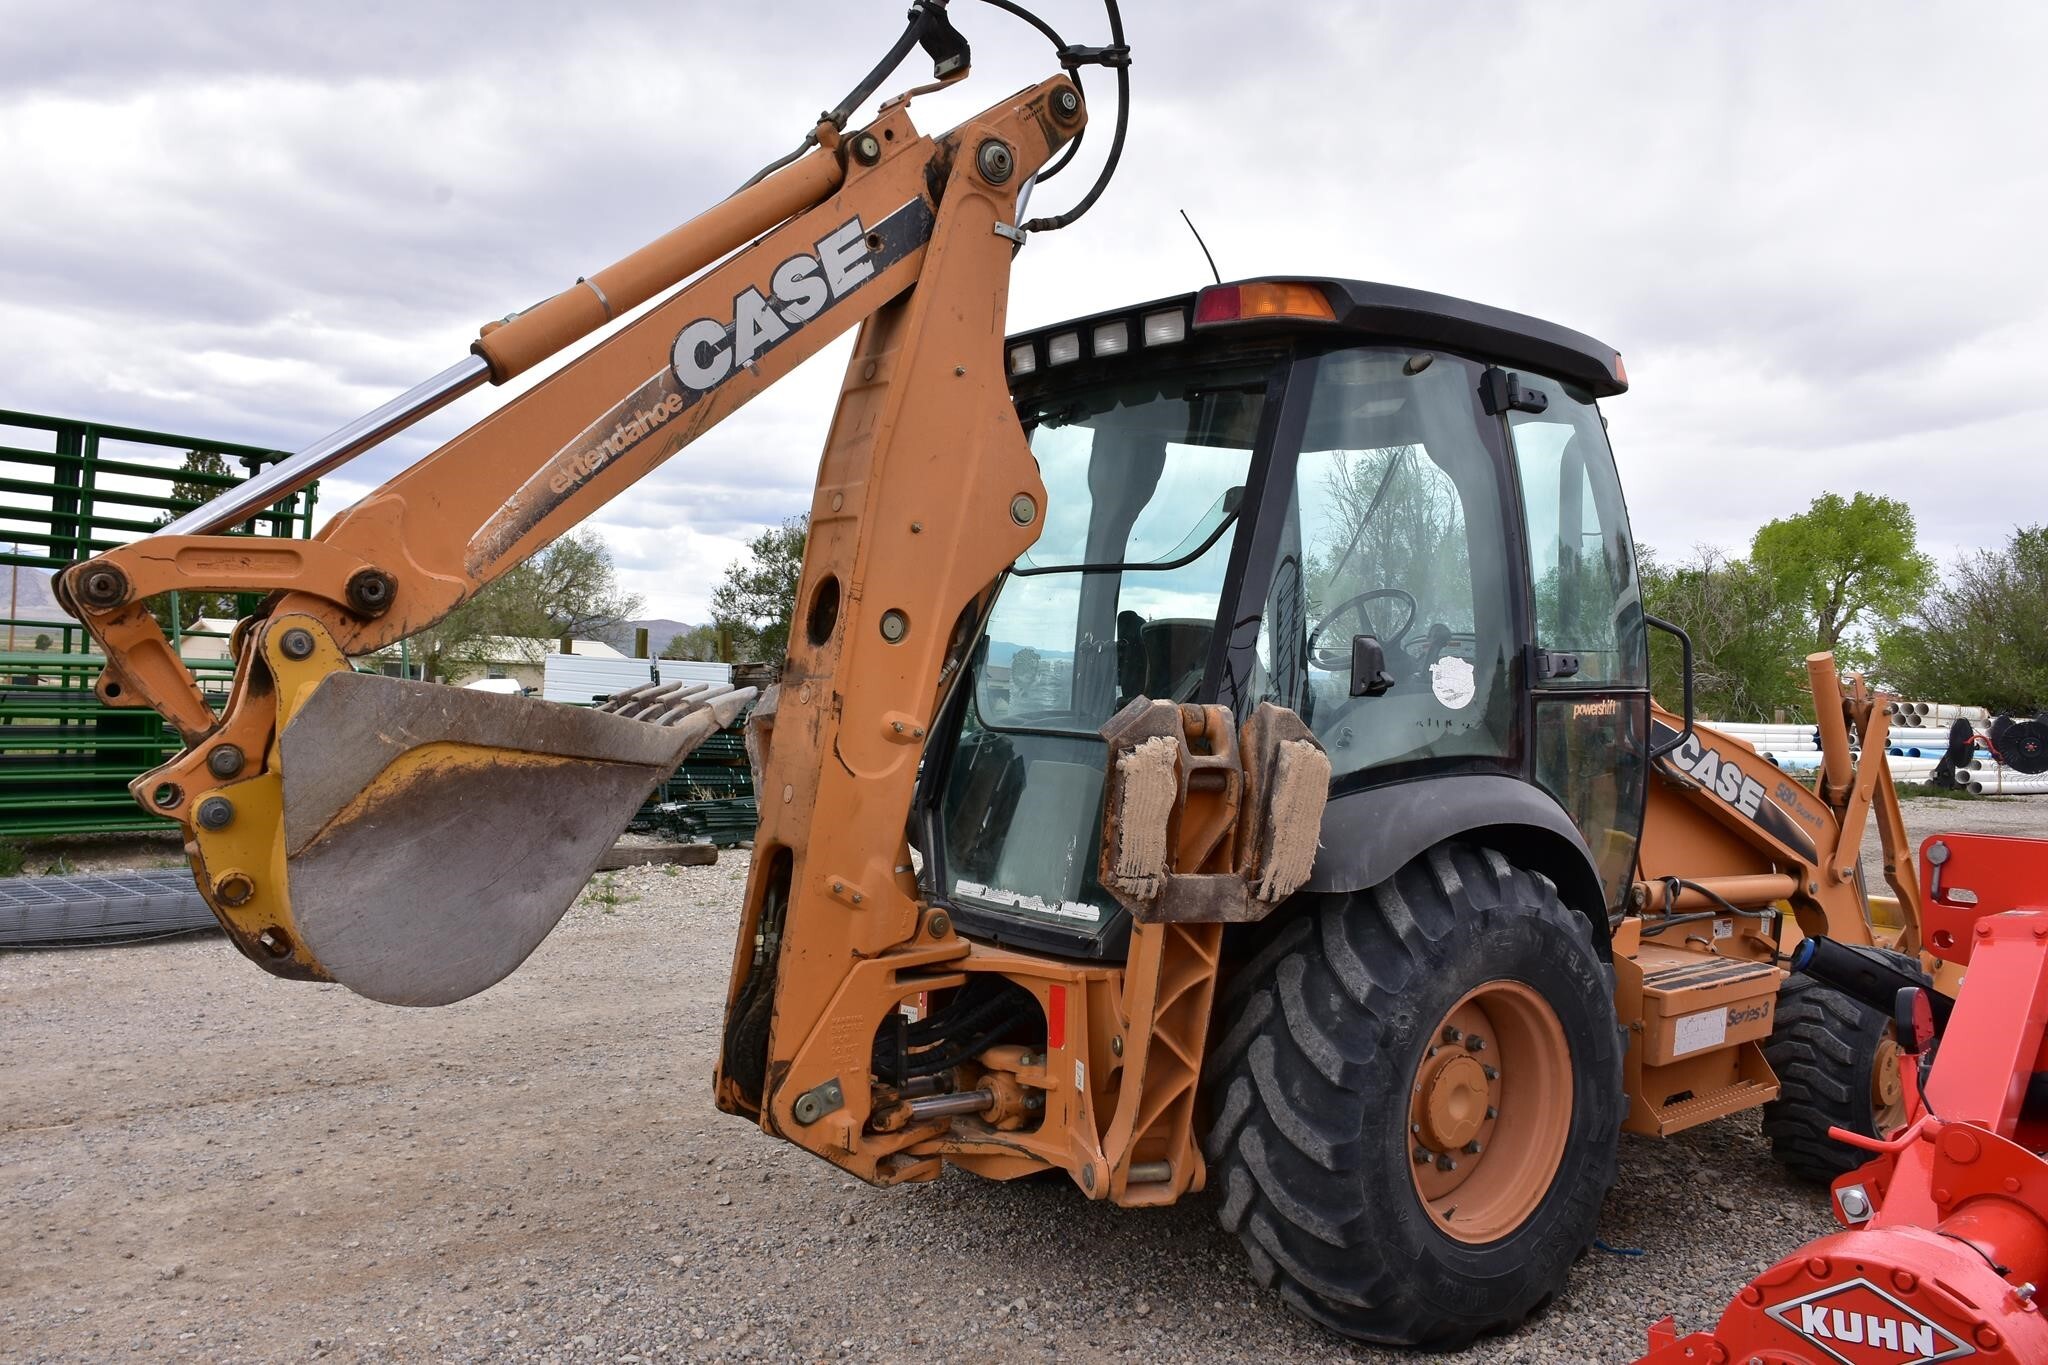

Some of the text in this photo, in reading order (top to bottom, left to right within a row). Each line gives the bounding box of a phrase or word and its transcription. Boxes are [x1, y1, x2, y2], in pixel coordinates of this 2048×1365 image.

[673, 217, 875, 390] CASE
[550, 393, 683, 494] extendahoe
[1573, 699, 1616, 719] powershift
[1671, 730, 1765, 819] CASE
[1776, 782, 1797, 806] 580
[1727, 1001, 1769, 1027] Series 3
[1800, 1303, 1935, 1358] KUHN
